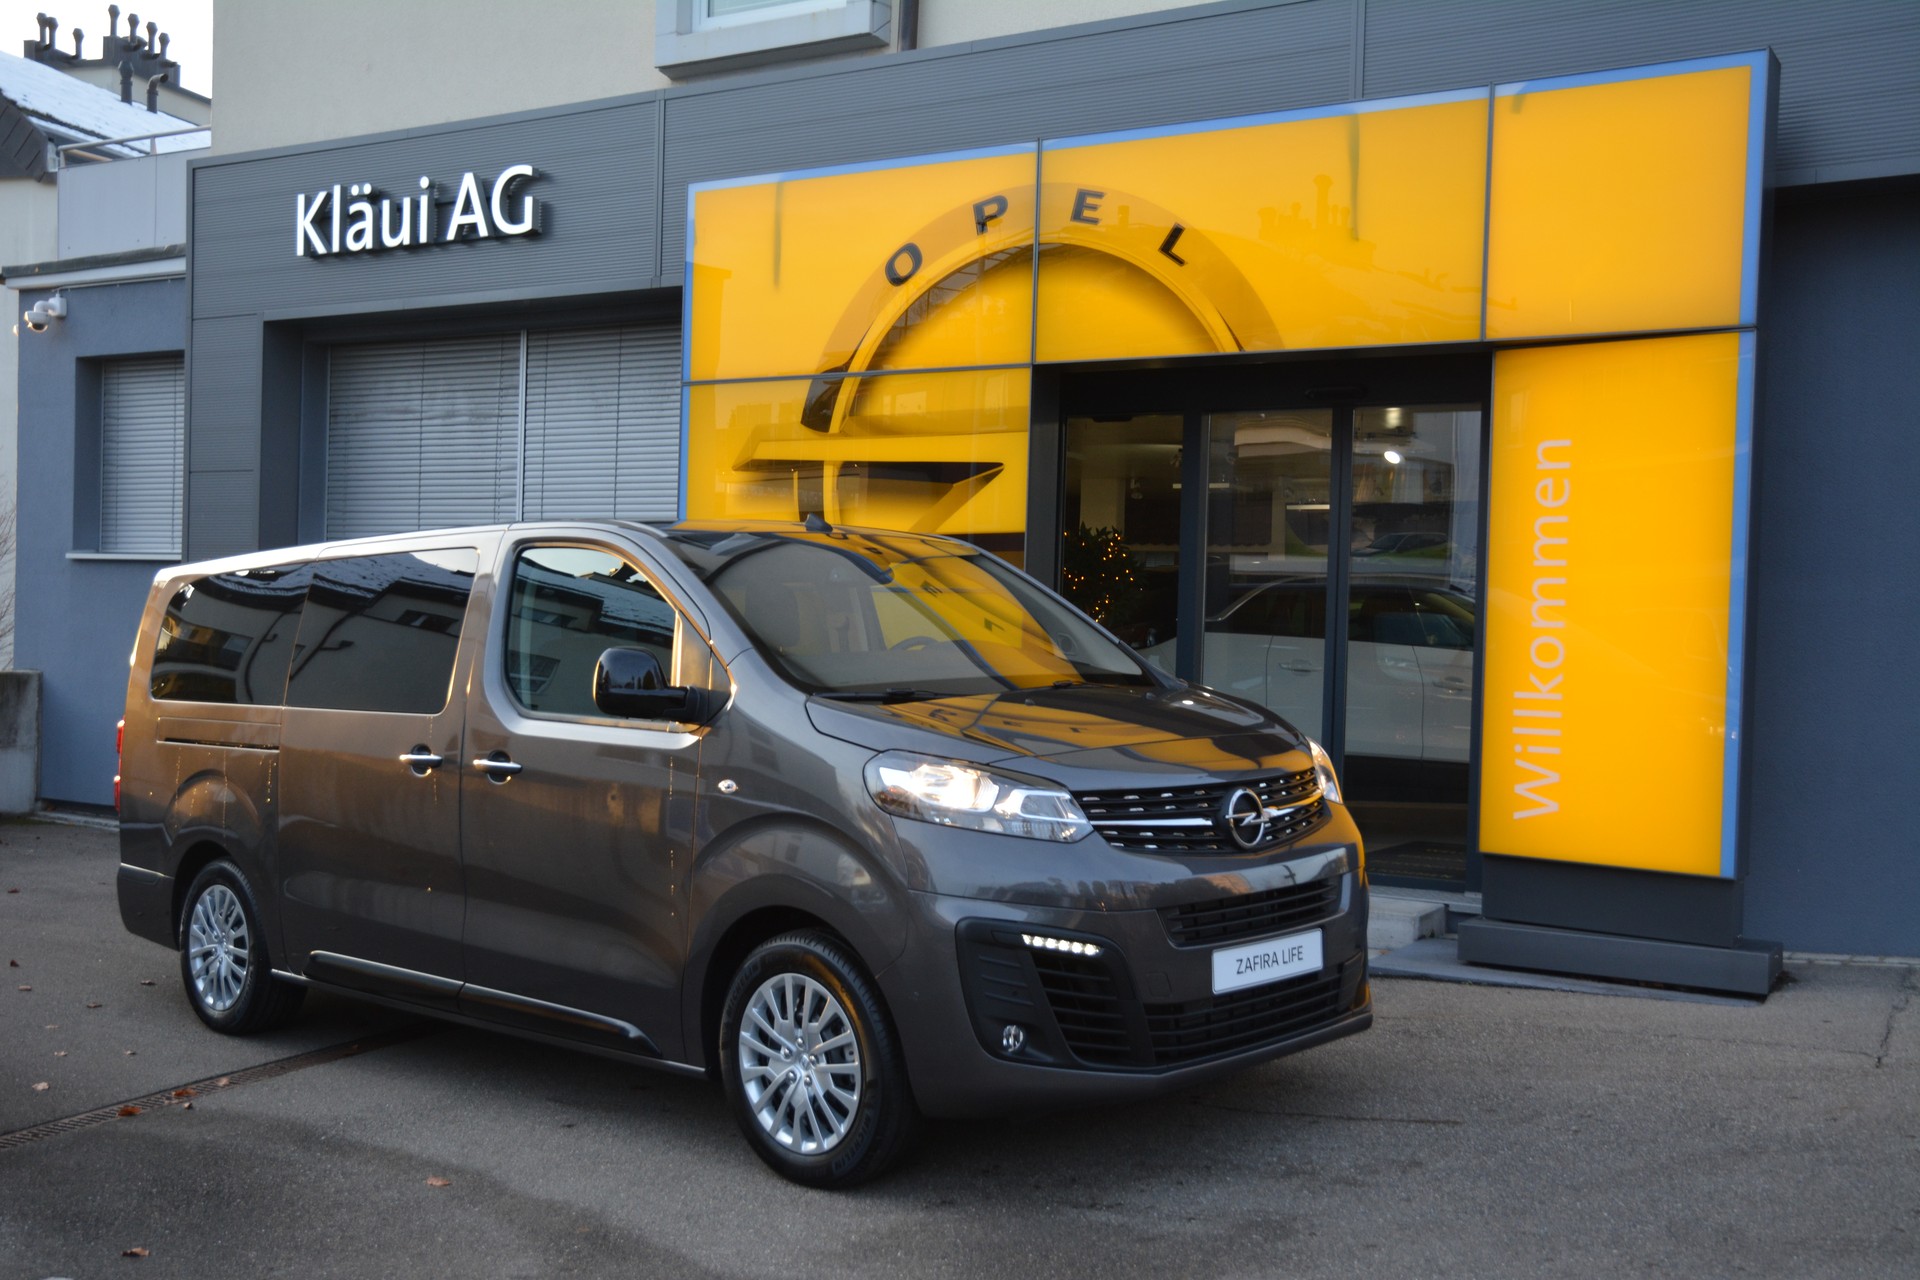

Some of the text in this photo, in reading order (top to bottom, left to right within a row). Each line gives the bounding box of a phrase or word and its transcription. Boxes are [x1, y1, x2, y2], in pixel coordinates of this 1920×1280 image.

[296, 164, 534, 257] Kläui AG
[885, 188, 1188, 287] OPEL
[1512, 439, 1572, 820] Willkommen
[1236, 945, 1304, 975] ZAFIRA LIFE
[831, 1112, 874, 1171] MICHELIN
